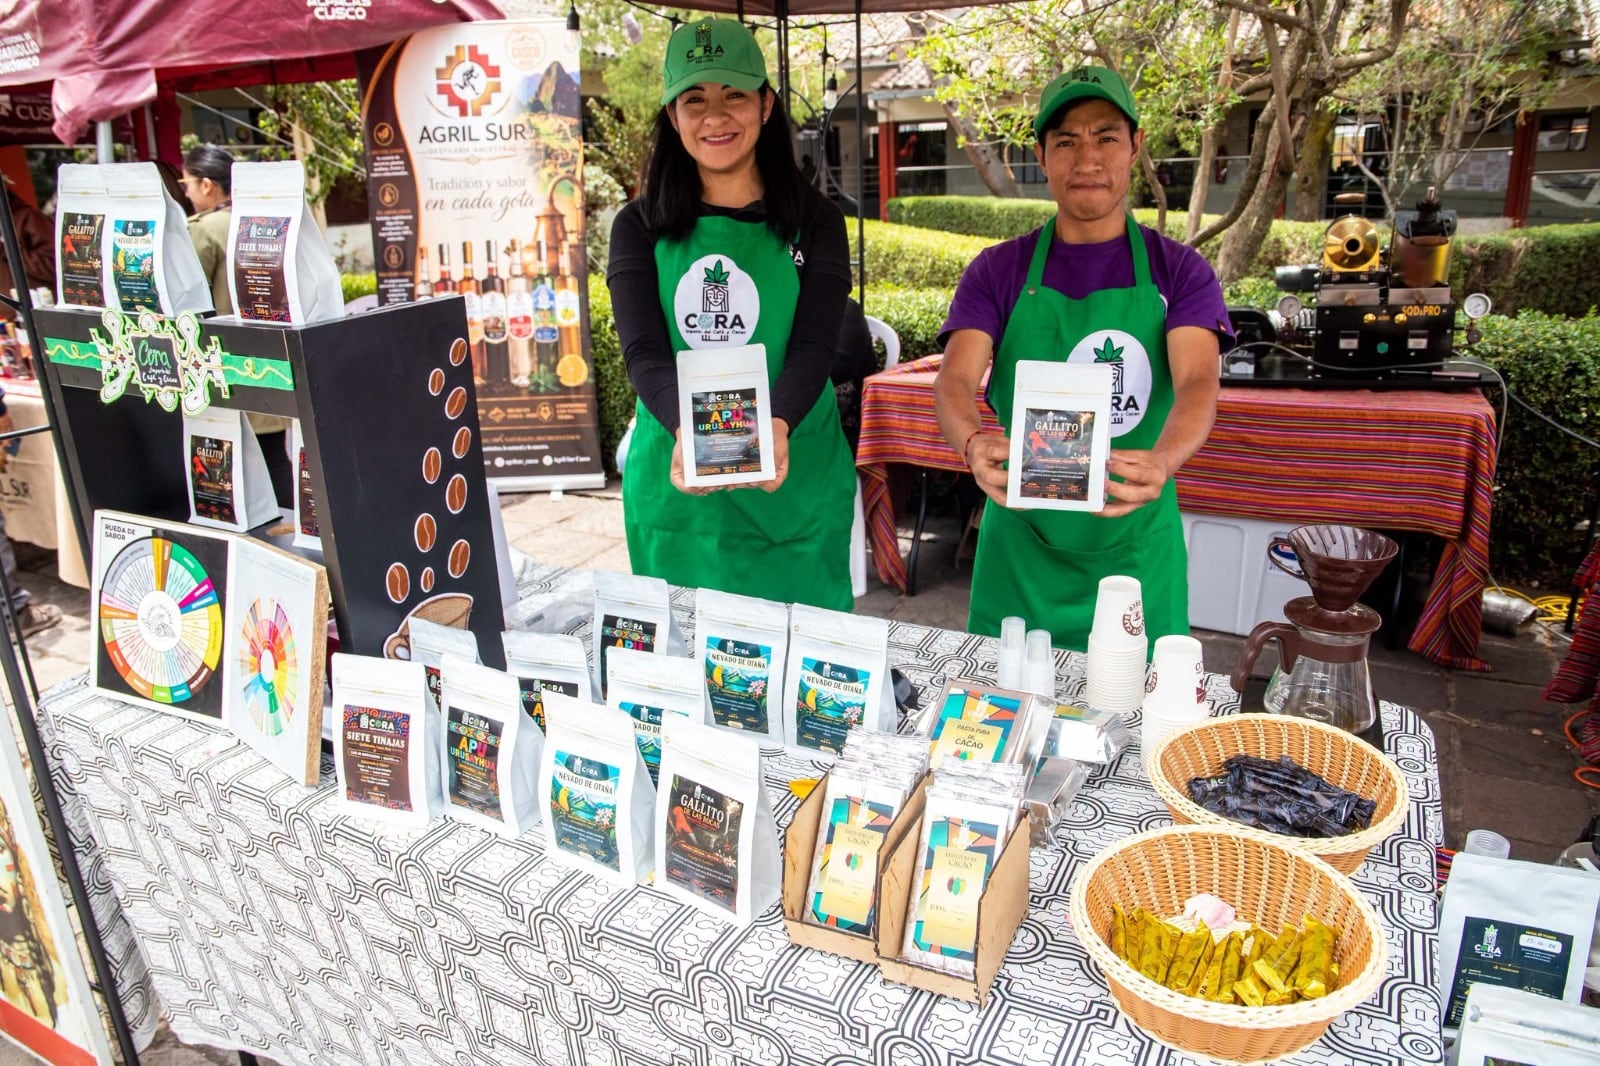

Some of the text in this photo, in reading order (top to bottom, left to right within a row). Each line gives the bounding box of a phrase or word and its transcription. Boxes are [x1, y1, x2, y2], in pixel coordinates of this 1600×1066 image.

[314, 7, 367, 20] CUSCO
[16, 104, 52, 121] CUS
[418, 123, 526, 144] AGRIL SUR
[496, 176, 527, 188] sabor
[425, 190, 536, 222] en cada gota
[256, 227, 278, 237] CORA
[238, 242, 282, 252] SIETE TINAJAS
[685, 313, 746, 329] CORA
[139, 339, 172, 369] Cora
[716, 393, 741, 401] CORA
[1111, 395, 1140, 411] RA
[710, 408, 744, 423] APU
[1034, 421, 1079, 432] GALLITO
[196, 447, 224, 460] GALLITO
[105, 524, 136, 536] RUEDA DE
[105, 531, 126, 542] SABOR
[623, 621, 643, 631] CORA
[711, 654, 737, 664] NEVADO
[806, 675, 832, 687] NEVADO
[541, 683, 564, 693] CORA
[369, 718, 395, 730] CORA
[468, 717, 490, 730] CORA
[633, 721, 652, 731] VADO
[956, 723, 976, 733] PASTA
[346, 731, 406, 748] SIETE TINAJAS
[955, 738, 984, 750] CACAO
[458, 735, 488, 758] APU
[450, 745, 497, 771] URUSAYHUA
[558, 771, 613, 795] NEVADO DE OTAÑA
[681, 794, 725, 823] GALLITO
[683, 807, 721, 829] DE LAS ROCAS
[1474, 943, 1502, 955] CORA
